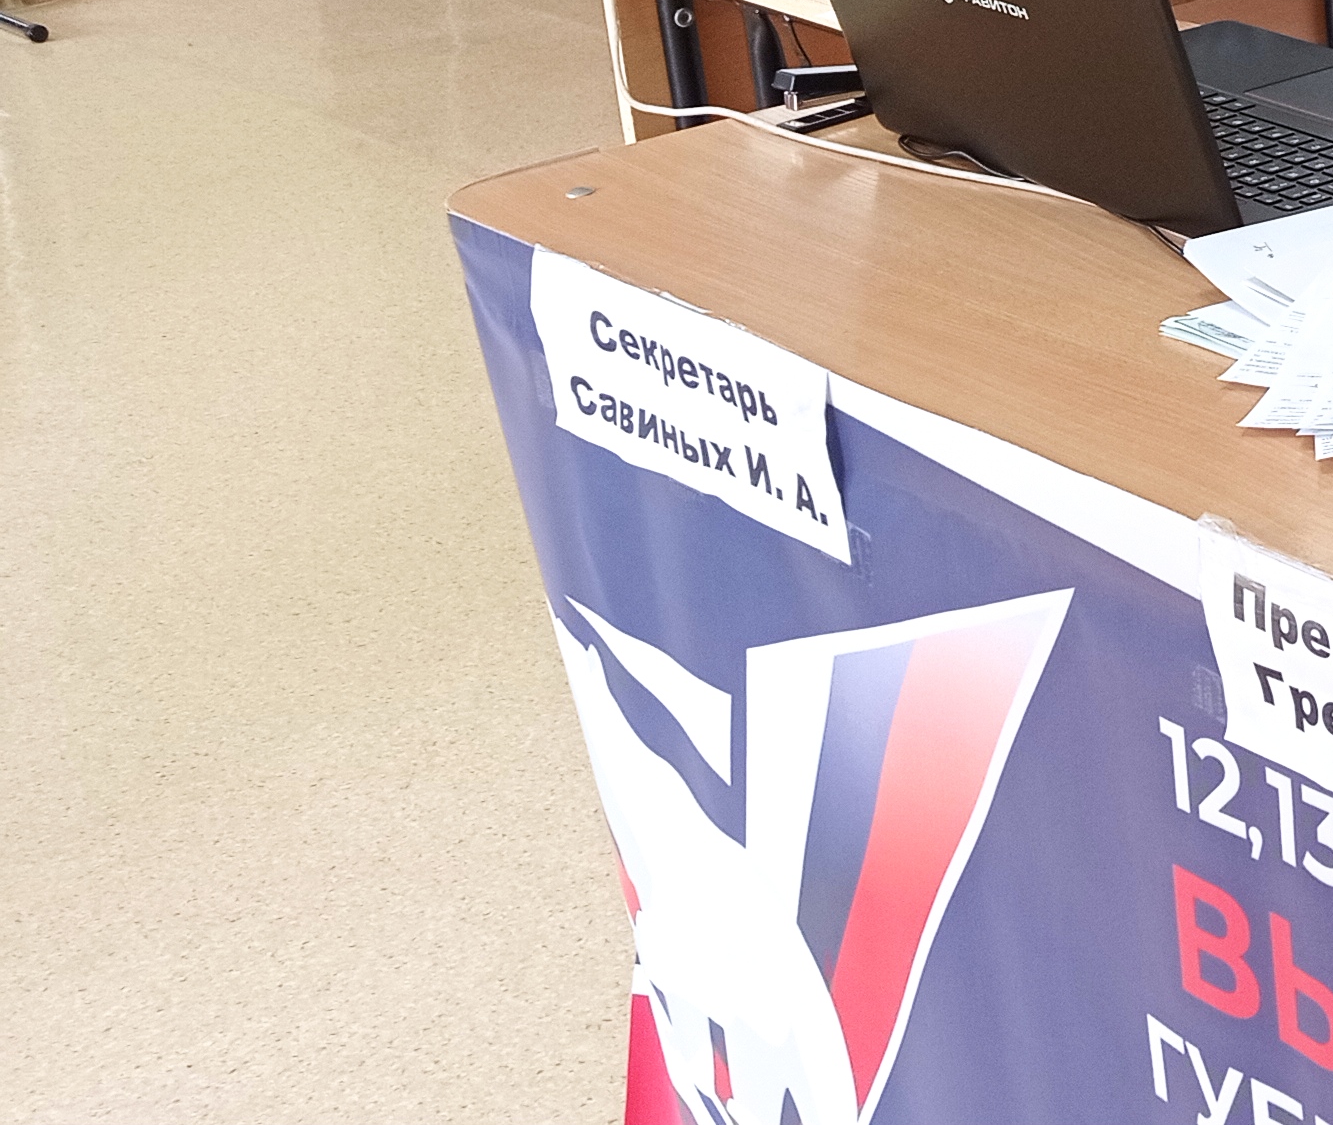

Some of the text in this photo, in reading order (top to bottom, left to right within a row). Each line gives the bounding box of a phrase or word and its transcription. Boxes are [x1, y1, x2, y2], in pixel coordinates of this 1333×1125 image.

[590, 310, 778, 426] Секретарь
[570, 376, 829, 527] Савиных И. А.
